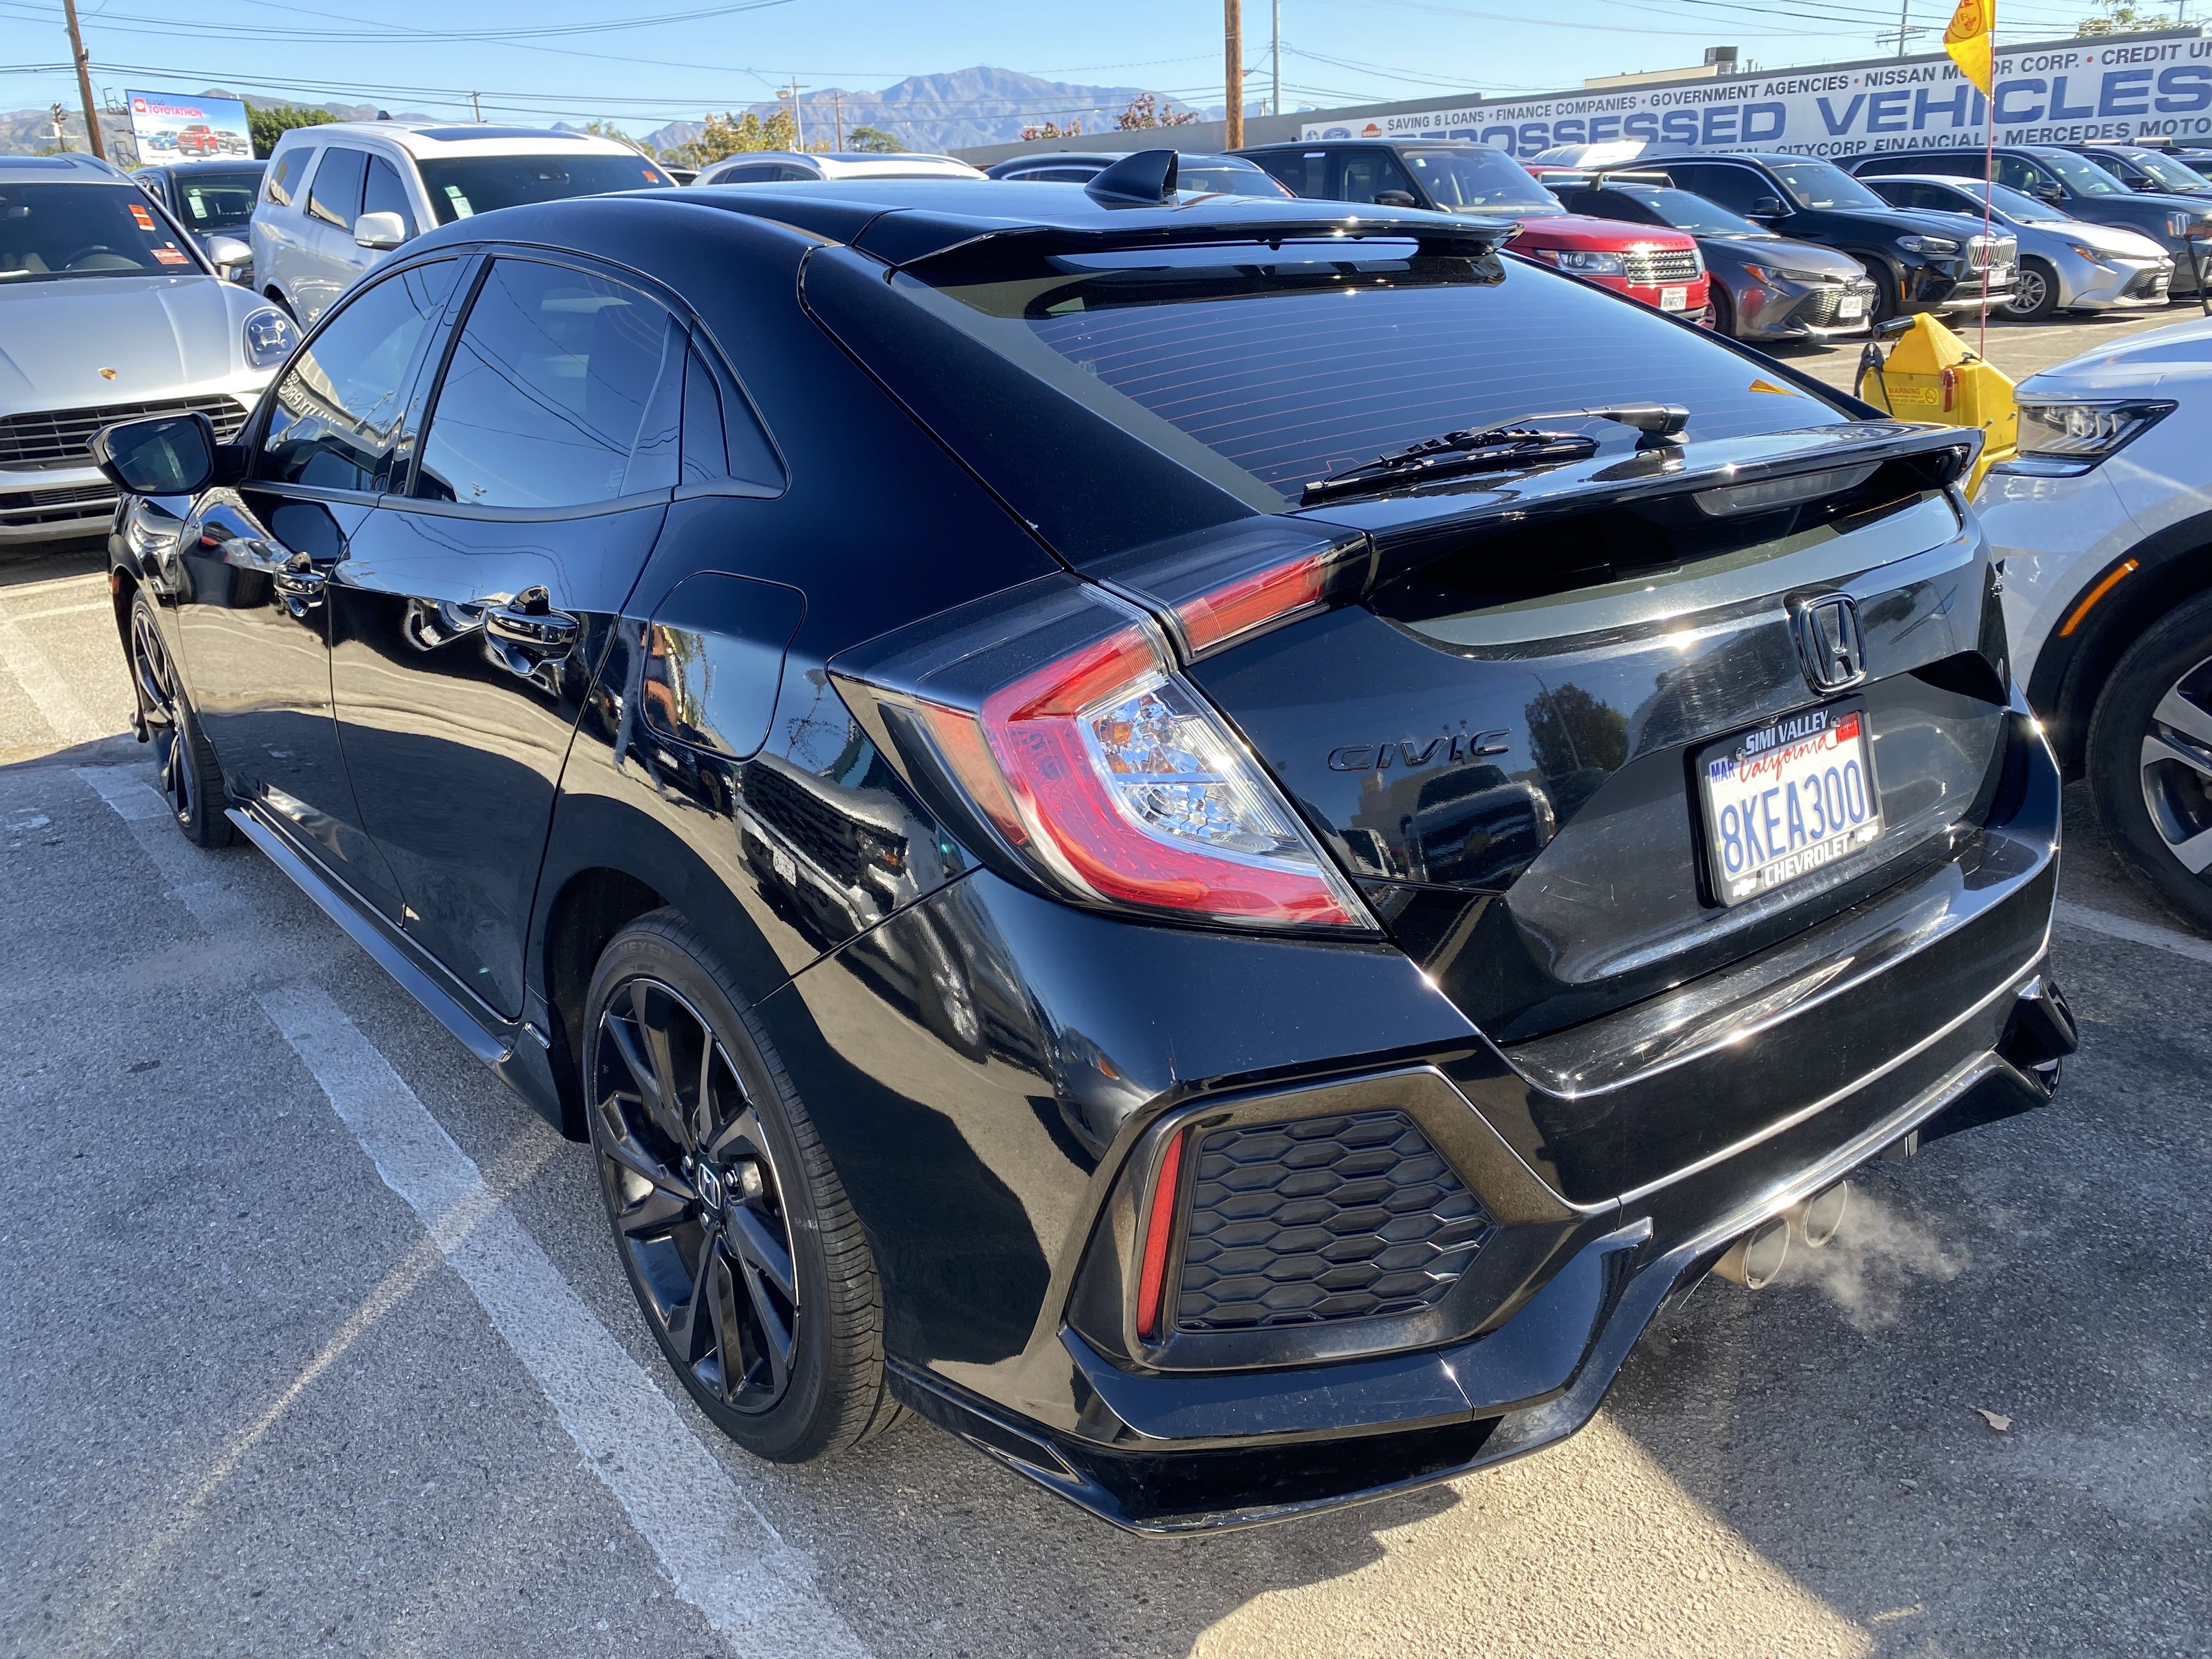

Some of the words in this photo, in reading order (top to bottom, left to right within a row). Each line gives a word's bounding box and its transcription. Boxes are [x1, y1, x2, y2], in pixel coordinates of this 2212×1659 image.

[1387, 115, 1430, 131] SAVING
[1434, 115, 1441, 126] &
[1444, 111, 1485, 125] LOANS
[1496, 104, 1551, 121] FINANCE
[1556, 96, 1637, 115] COMPANIES
[1650, 83, 1759, 107] GOVERNMENT
[1763, 75, 1849, 98] AGENCIES
[1865, 66, 1937, 87] NISSAN
[1943, 58, 2013, 80] MOR
[2021, 53, 2079, 72] CORP.
[2101, 43, 2182, 65] CREDIT
[148, 105, 202, 117] TOYOTATHON
[1389, 101, 1787, 158] OSSESSED
[1816, 65, 2212, 136] VEHICLES
[1776, 141, 1867, 156] CITYCORP
[1874, 132, 1985, 151] FINANCIAL
[2005, 122, 2131, 145] MERCEDES
[1327, 728, 1512, 771] CIVIC
[1746, 726, 1776, 756] SIMI
[1778, 710, 1829, 743] VALLEY
[1711, 758, 1736, 784] MAR
[1739, 733, 1838, 783] California
[1720, 759, 1866, 873] 8KEA300
[1764, 833, 1850, 887] CHEVROLET
[619, 941, 670, 964] NEXEN
